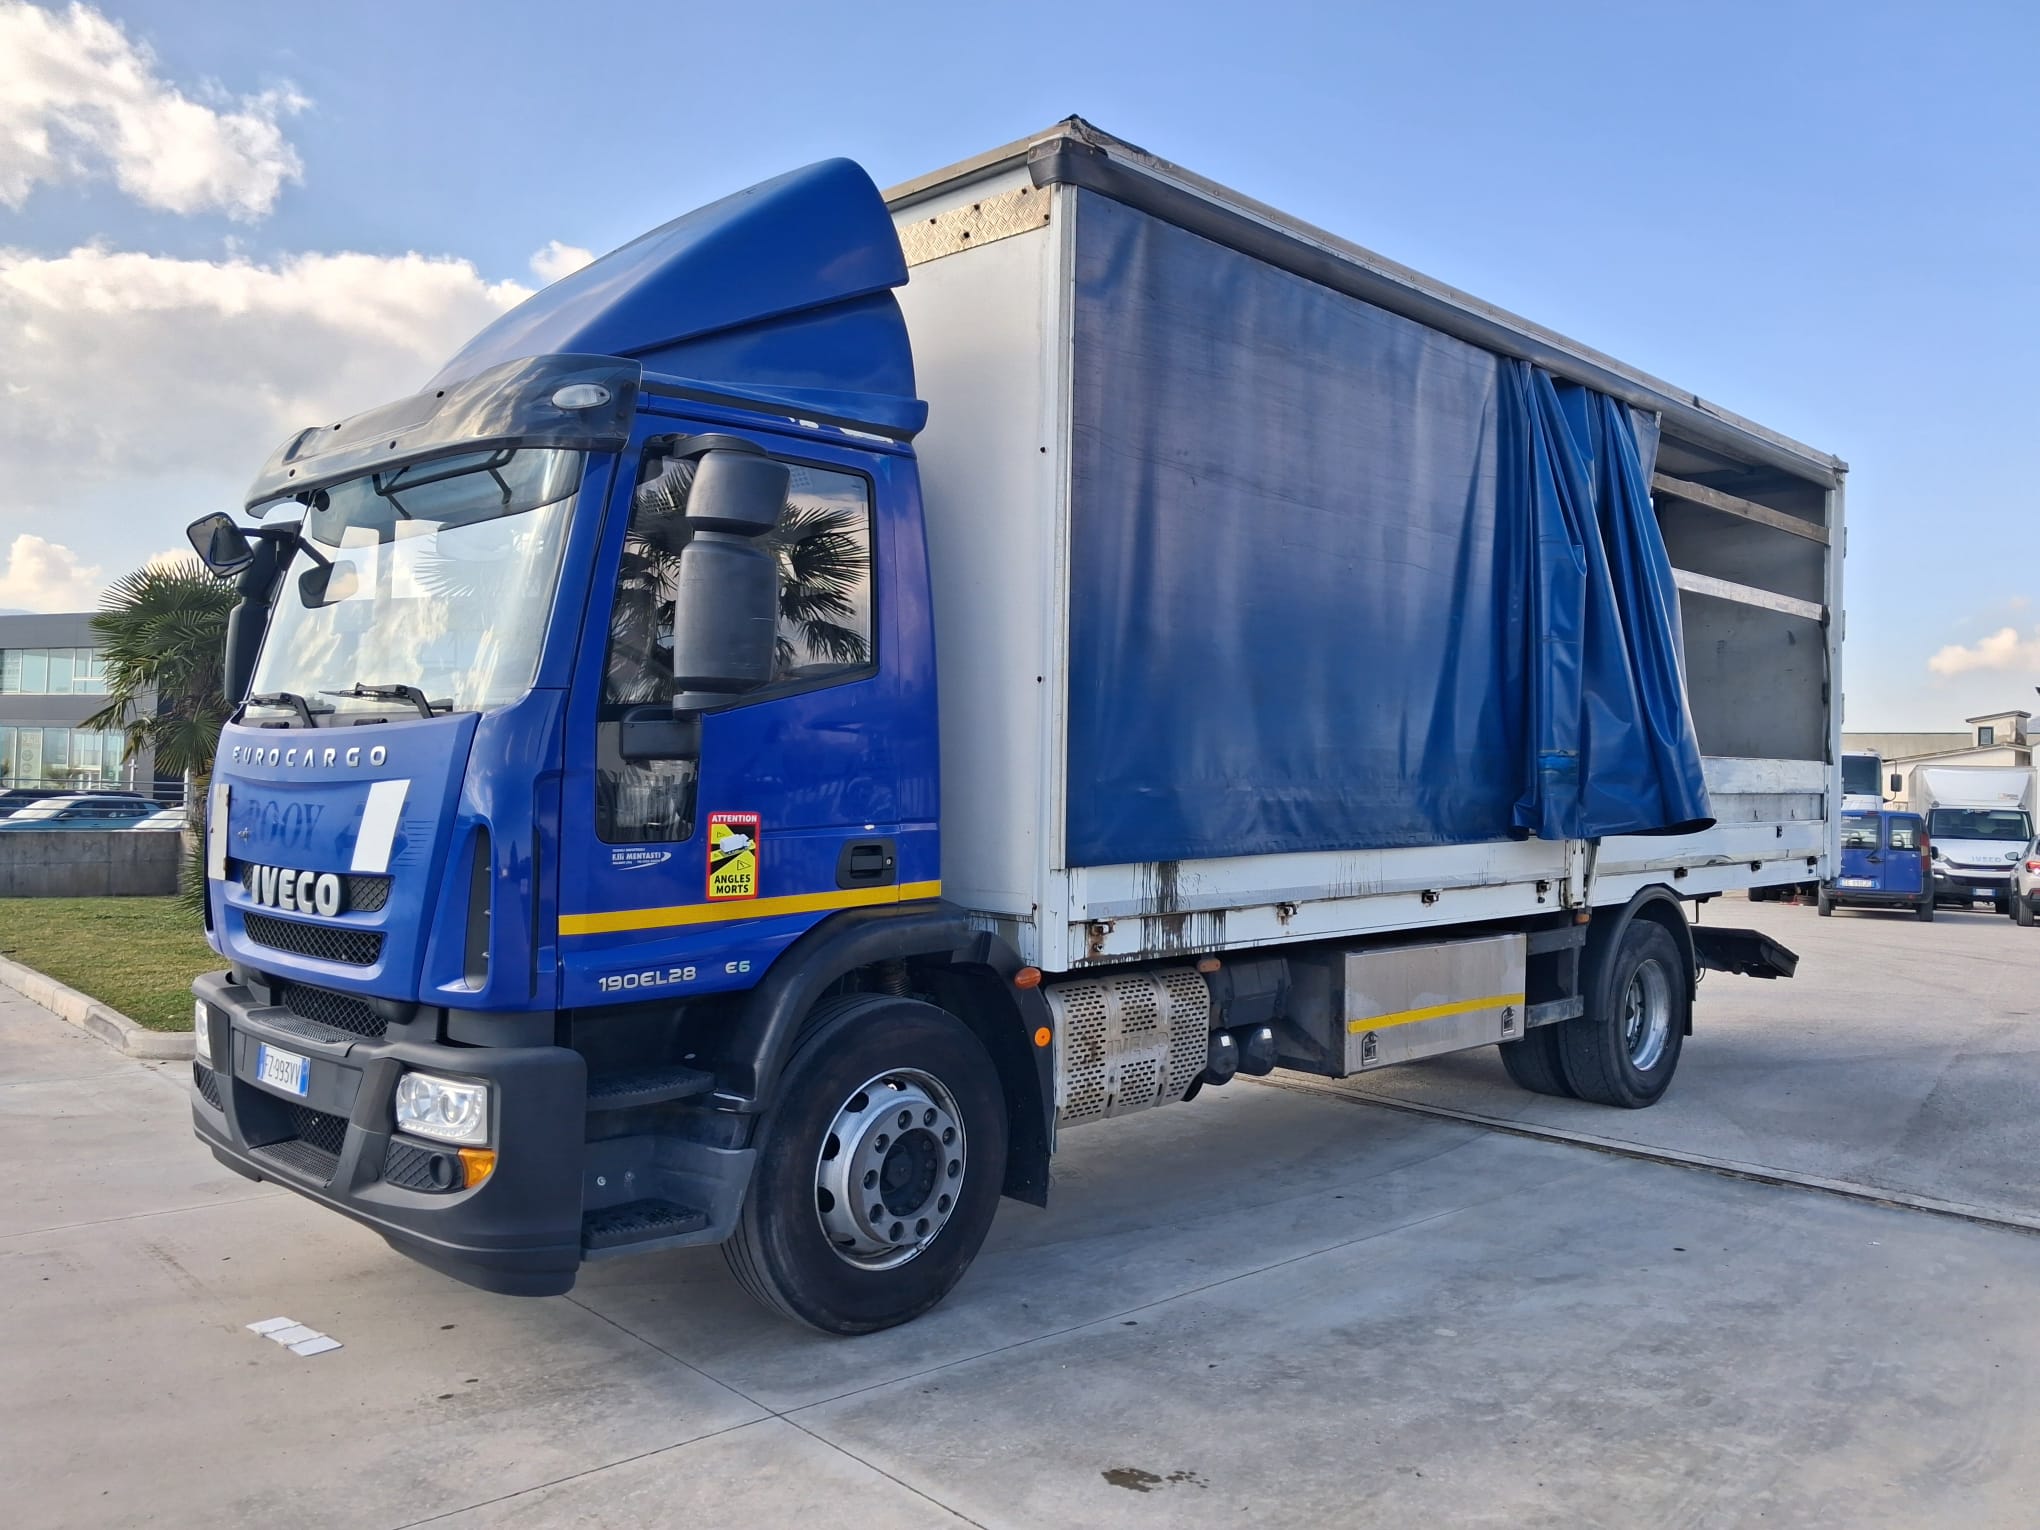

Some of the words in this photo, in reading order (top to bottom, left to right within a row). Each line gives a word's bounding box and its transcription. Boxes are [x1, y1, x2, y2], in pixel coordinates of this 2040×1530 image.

[232, 745, 387, 768] EUROCARGO
[712, 814, 758, 823] ATTENTION
[714, 874, 751, 884] ANGLES
[251, 864, 342, 917] IVECO
[716, 885, 749, 894] MORTS
[598, 966, 697, 992] 190EL28
[725, 960, 751, 974] E6
